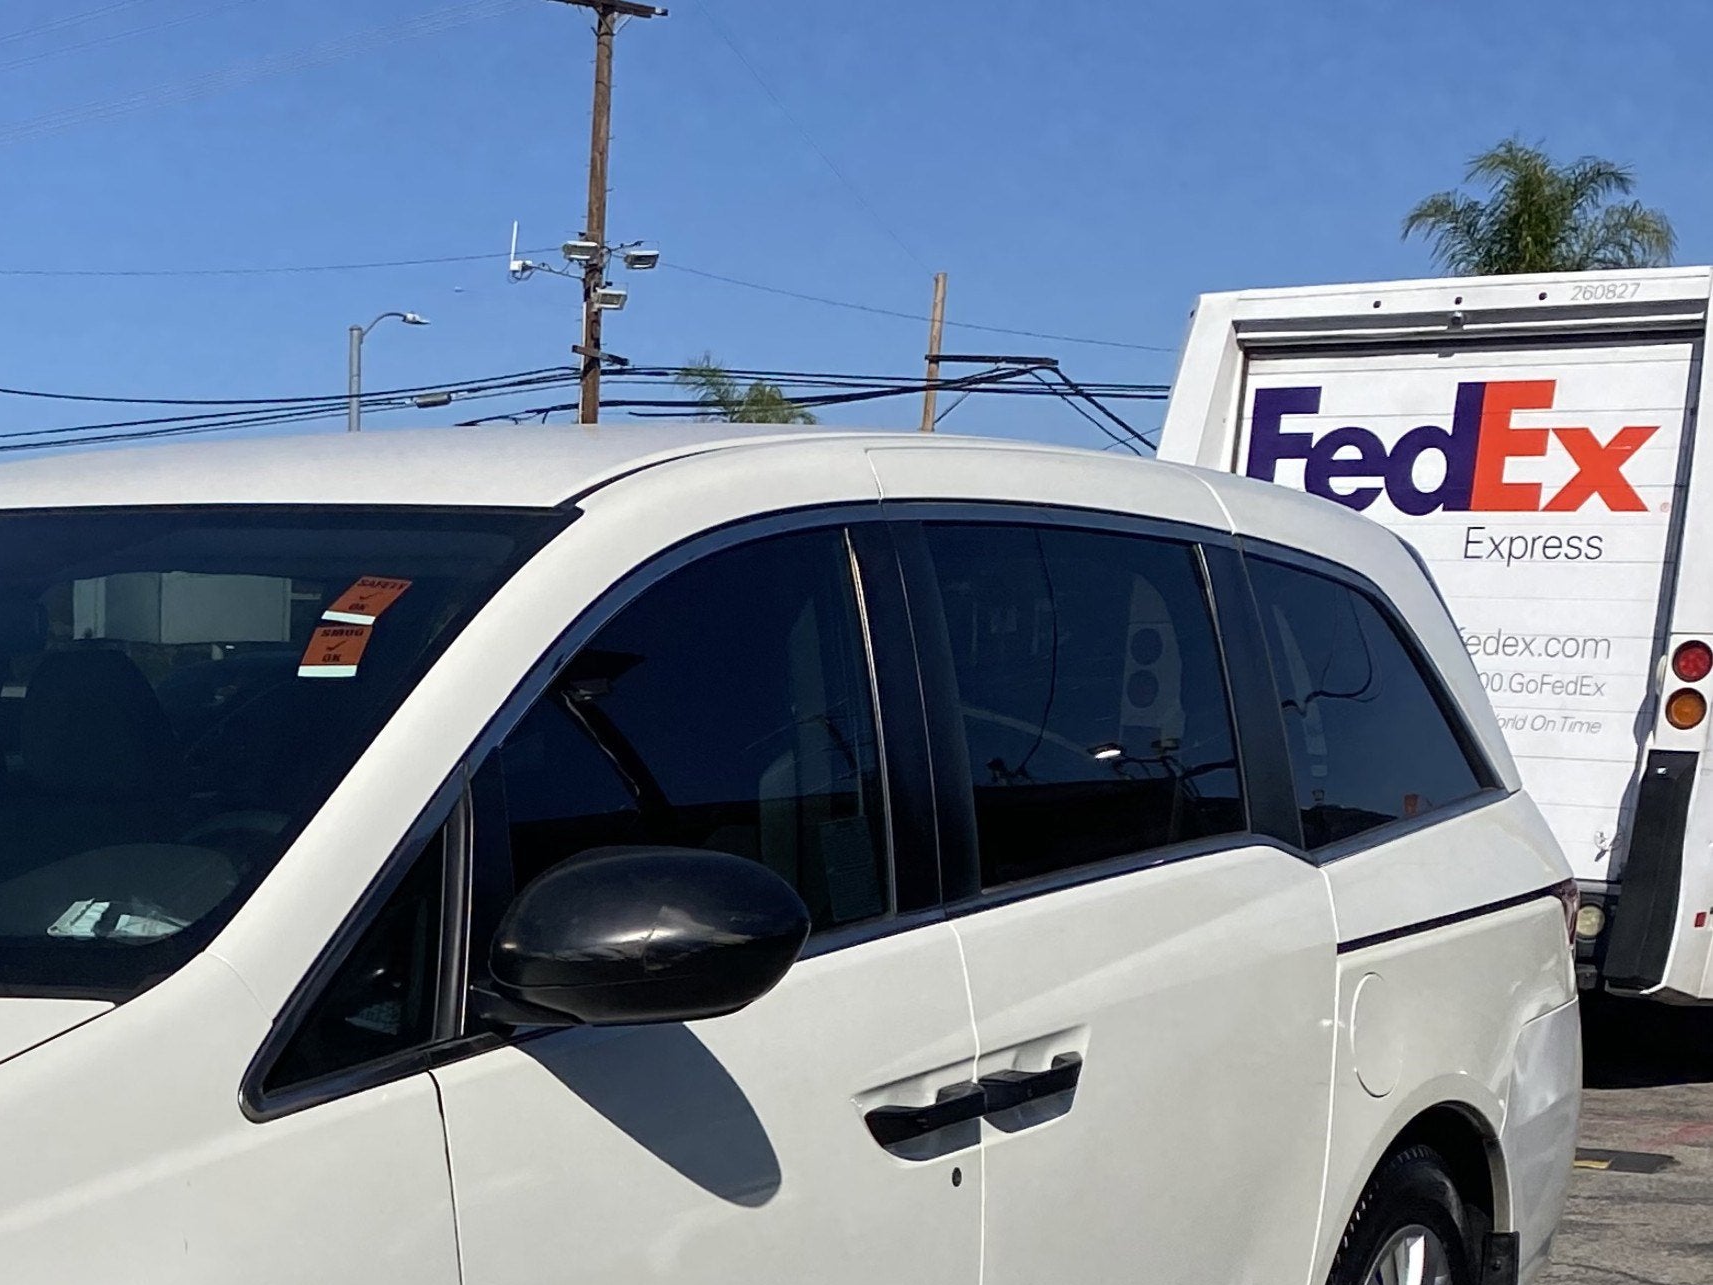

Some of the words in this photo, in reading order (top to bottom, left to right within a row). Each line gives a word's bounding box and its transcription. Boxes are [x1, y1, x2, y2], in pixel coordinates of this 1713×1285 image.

[1570, 281, 1641, 301] 260827
[1247, 379, 1661, 516] FedEx
[1463, 526, 1603, 567] Express
[321, 653, 341, 662] OK
[1530, 714, 1556, 732] On
[1560, 716, 1602, 734] Time
